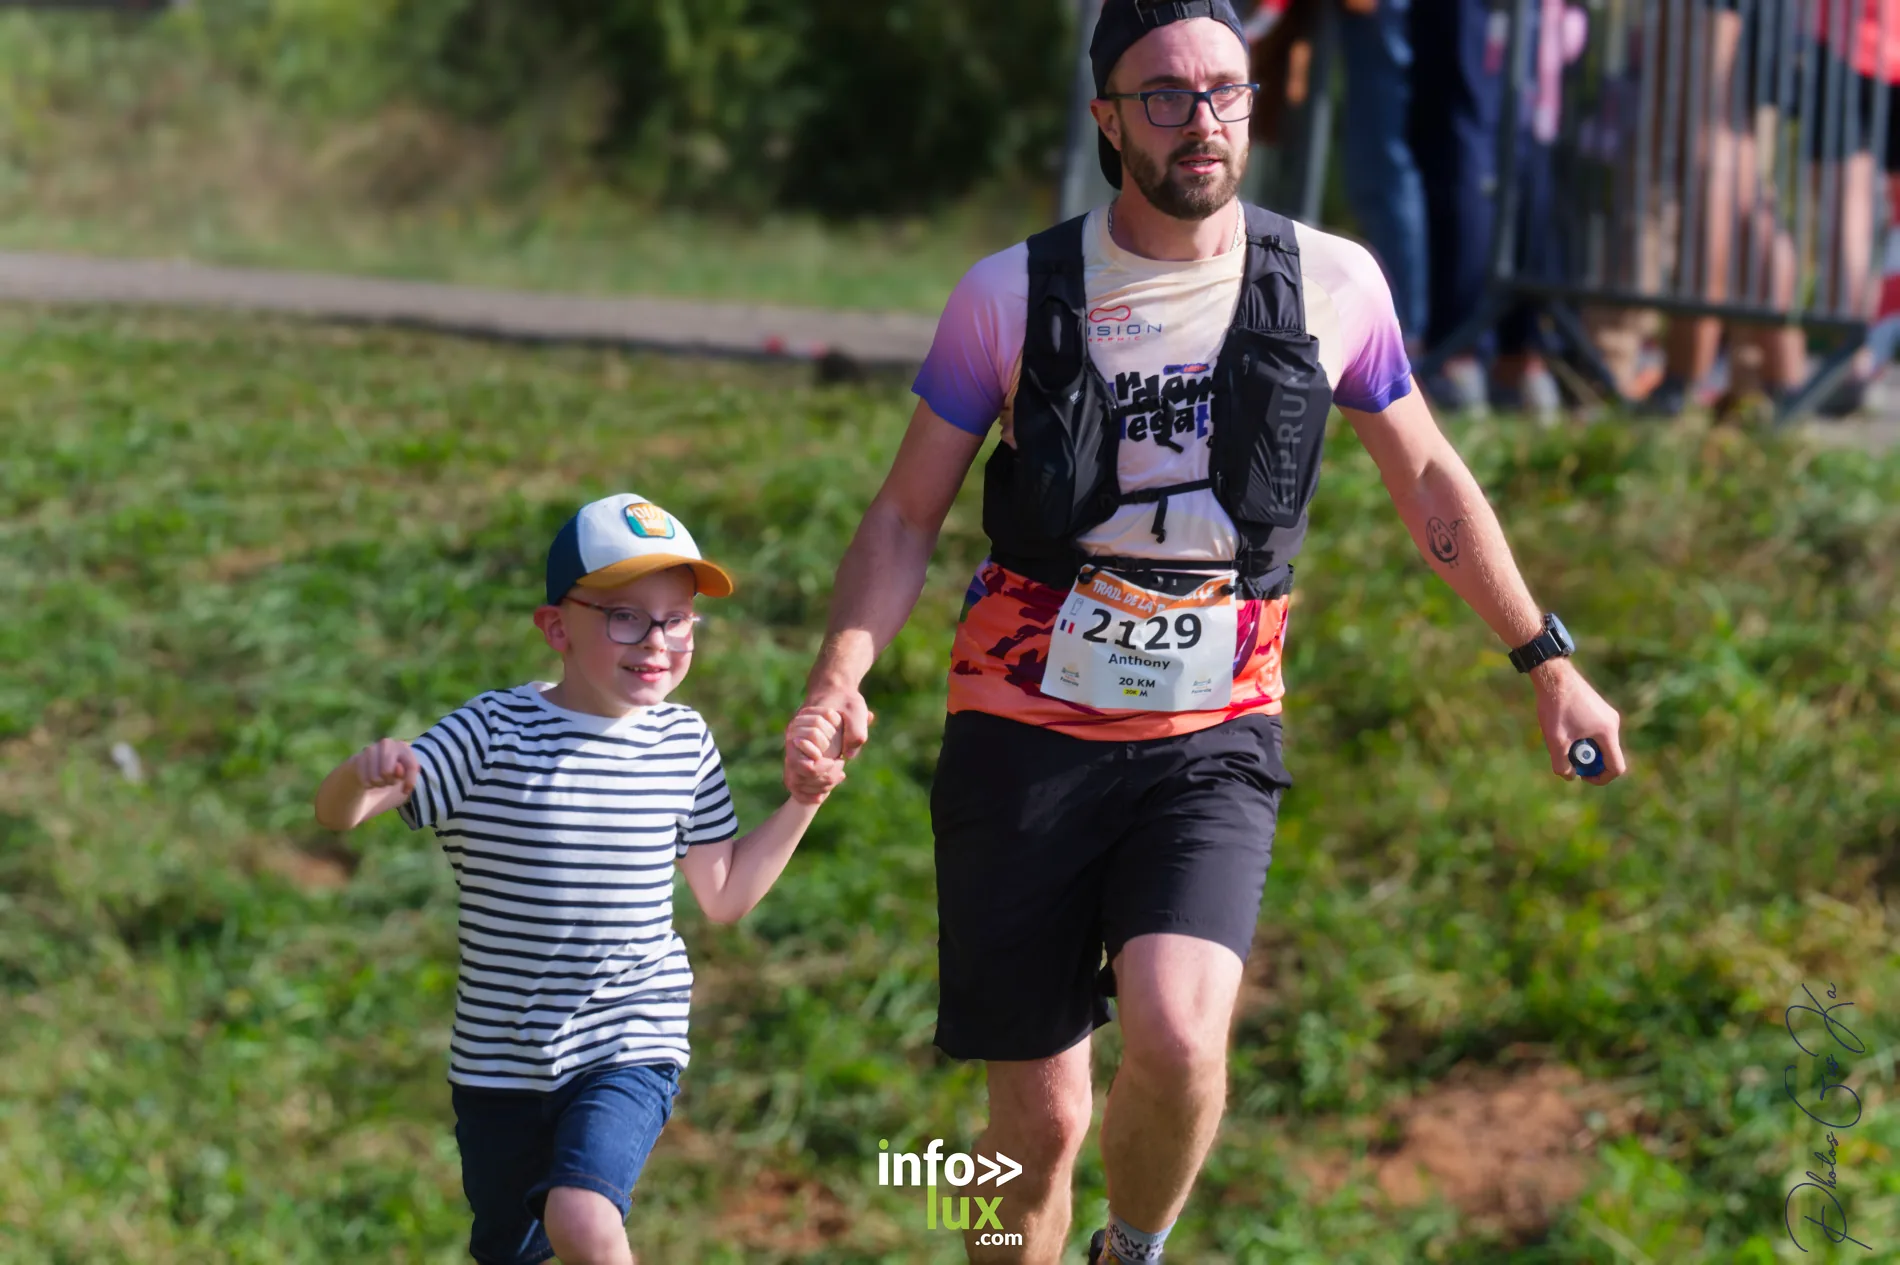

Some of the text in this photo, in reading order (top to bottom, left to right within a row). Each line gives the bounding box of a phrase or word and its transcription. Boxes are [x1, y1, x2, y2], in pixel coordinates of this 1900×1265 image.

[1087, 323, 1162, 336] ISION
[1269, 372, 1309, 516] KIPRUN
[1091, 579, 1122, 601] TRAIL
[1123, 593, 1138, 607] DE
[1137, 599, 1154, 614] LA
[1082, 608, 1202, 651] 2129
[1108, 653, 1171, 670] Anthony
[1119, 676, 1156, 688] 20 KM
[1138, 689, 1148, 697] M
